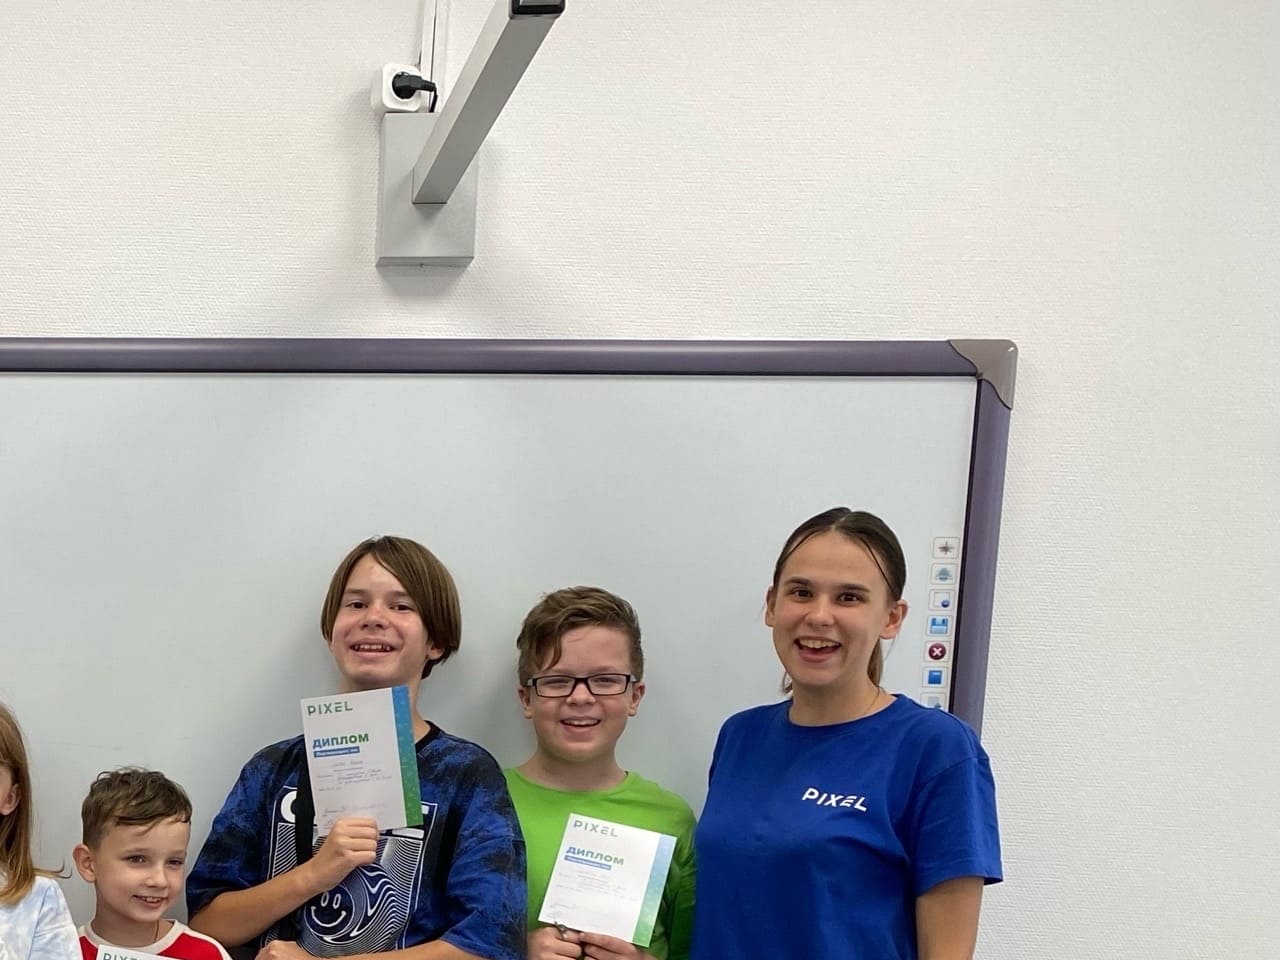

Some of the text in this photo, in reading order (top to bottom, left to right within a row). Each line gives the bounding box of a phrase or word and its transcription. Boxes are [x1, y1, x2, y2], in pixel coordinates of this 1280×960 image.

[307, 701, 353, 716] PIXEL
[312, 733, 369, 749] ДИПЛОМ
[801, 787, 867, 812] PIXEL
[573, 819, 619, 837] PIXEL
[566, 846, 625, 865] ДИПЛОМ
